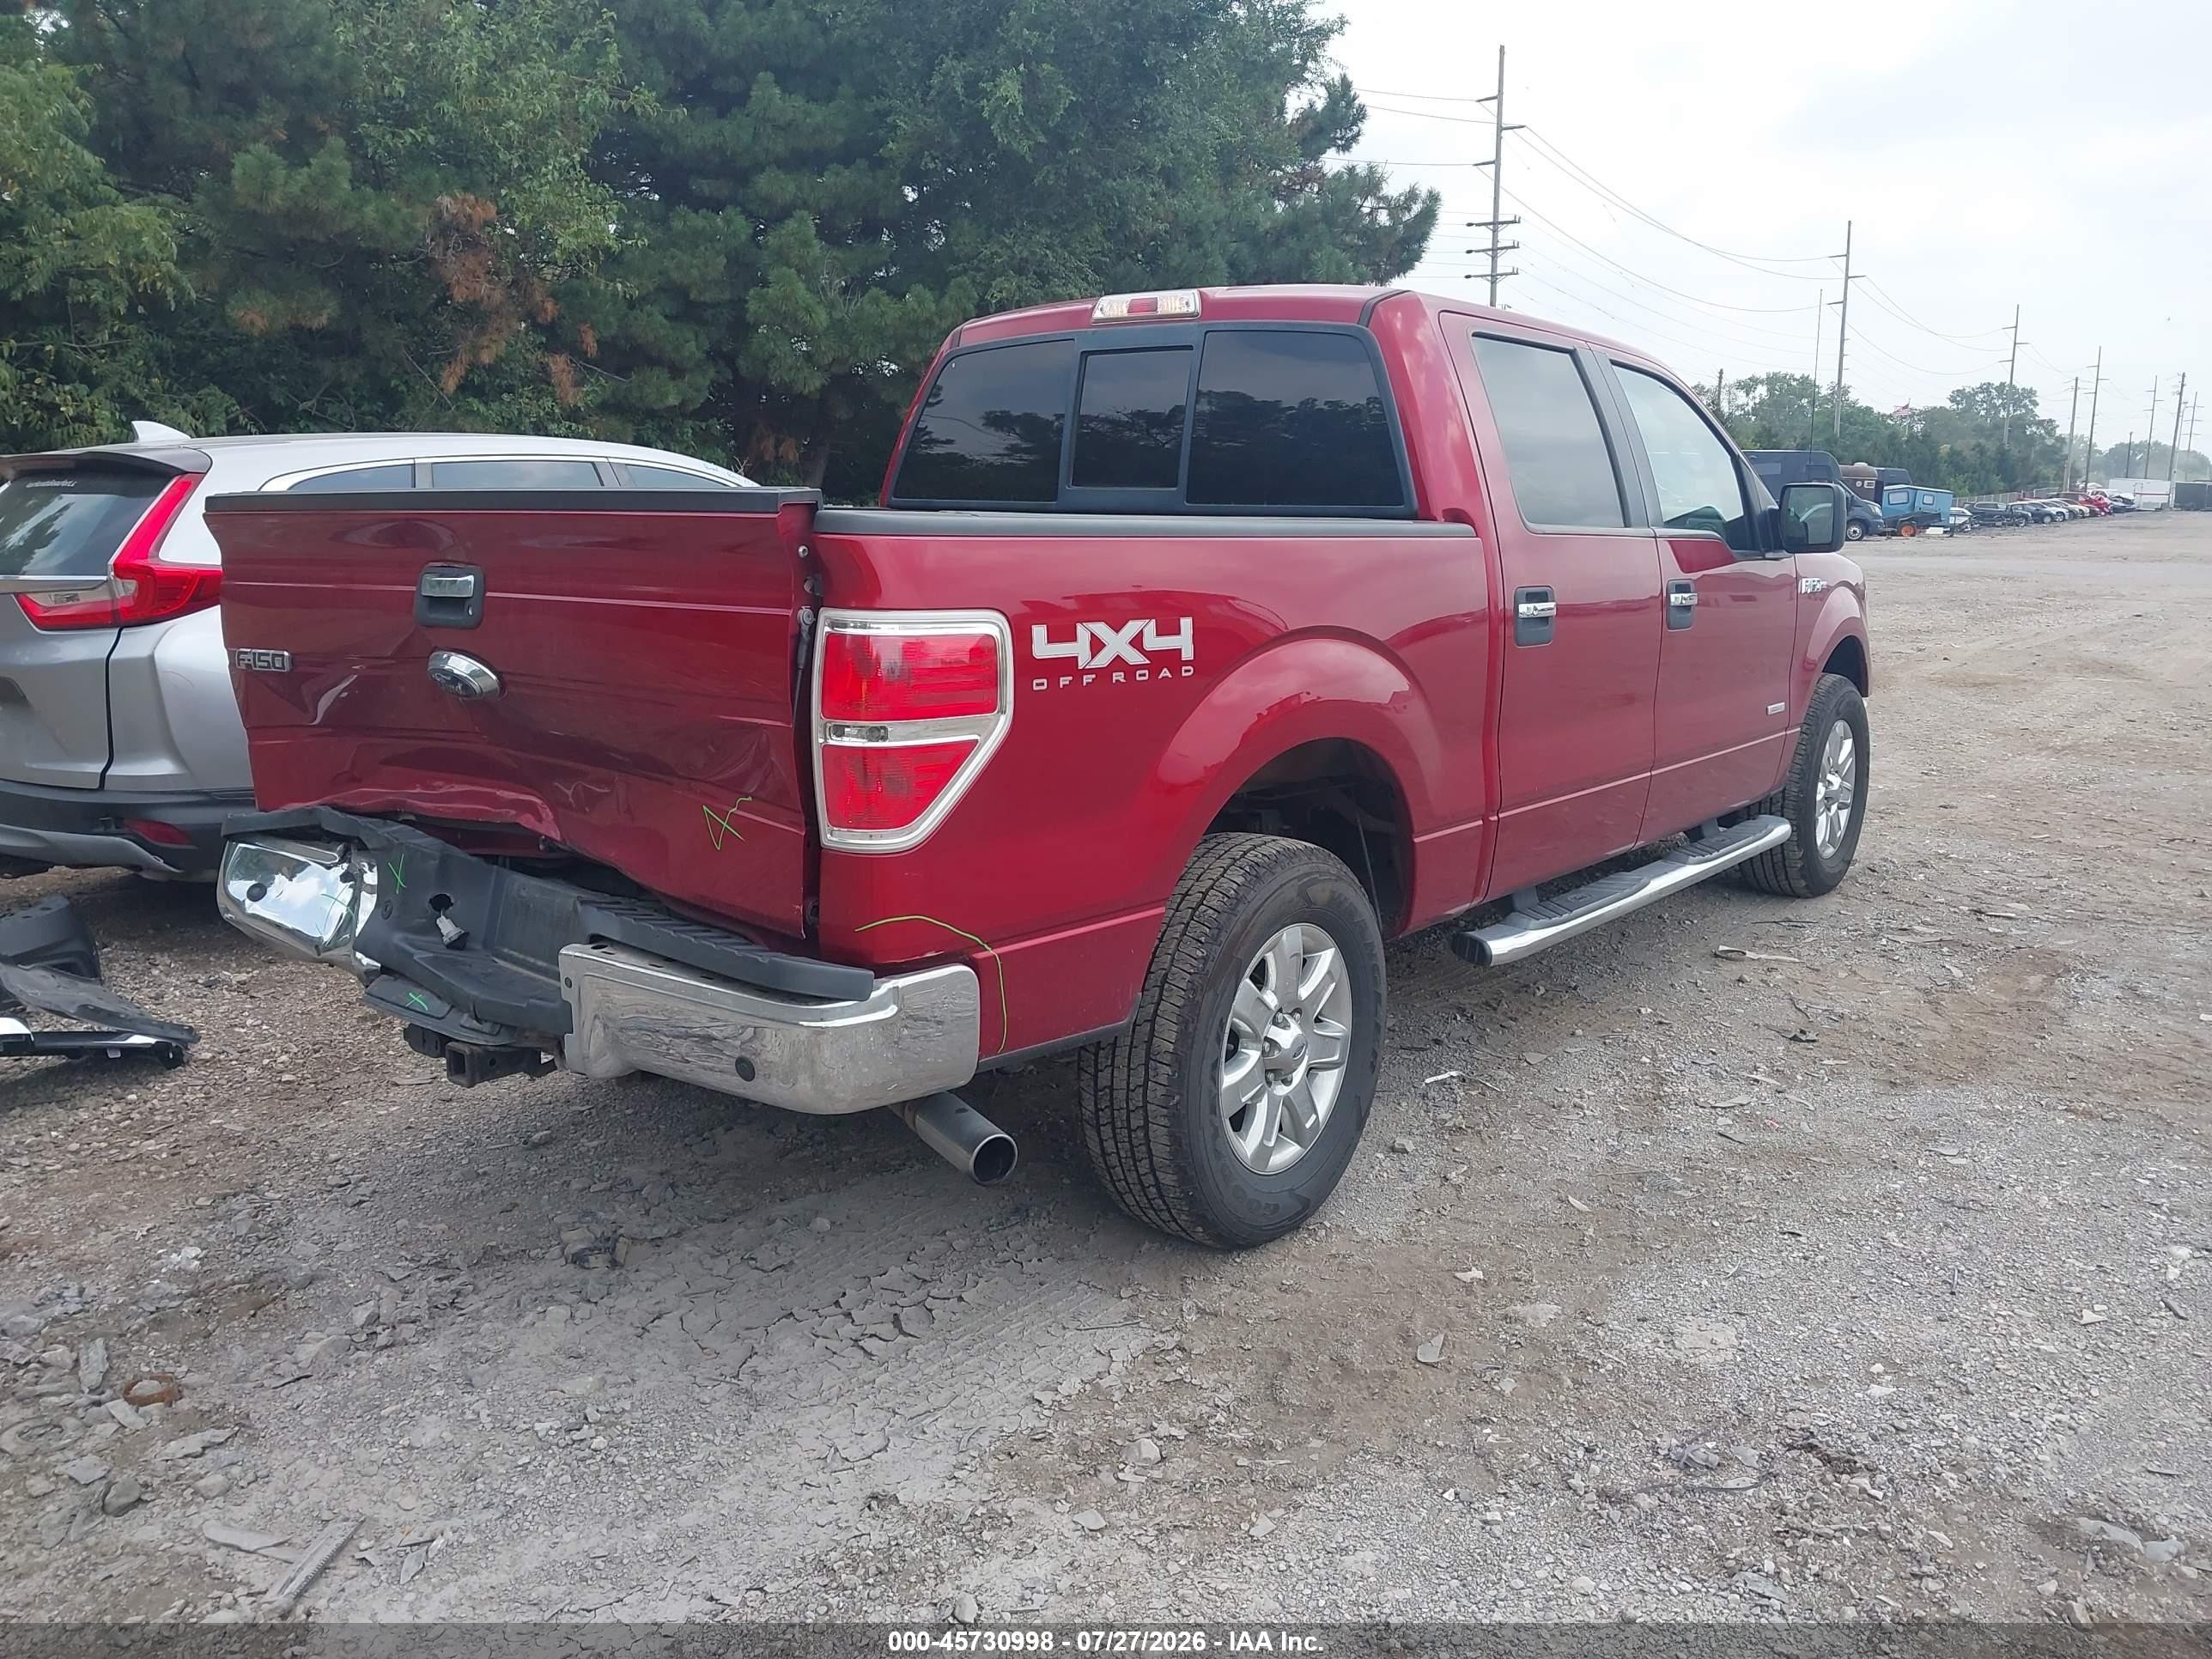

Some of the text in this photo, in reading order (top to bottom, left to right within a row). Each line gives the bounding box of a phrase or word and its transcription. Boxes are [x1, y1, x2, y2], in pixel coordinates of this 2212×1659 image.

[1031, 617, 1194, 669] 4X4
[1033, 665, 1194, 690] OFF ROAD
